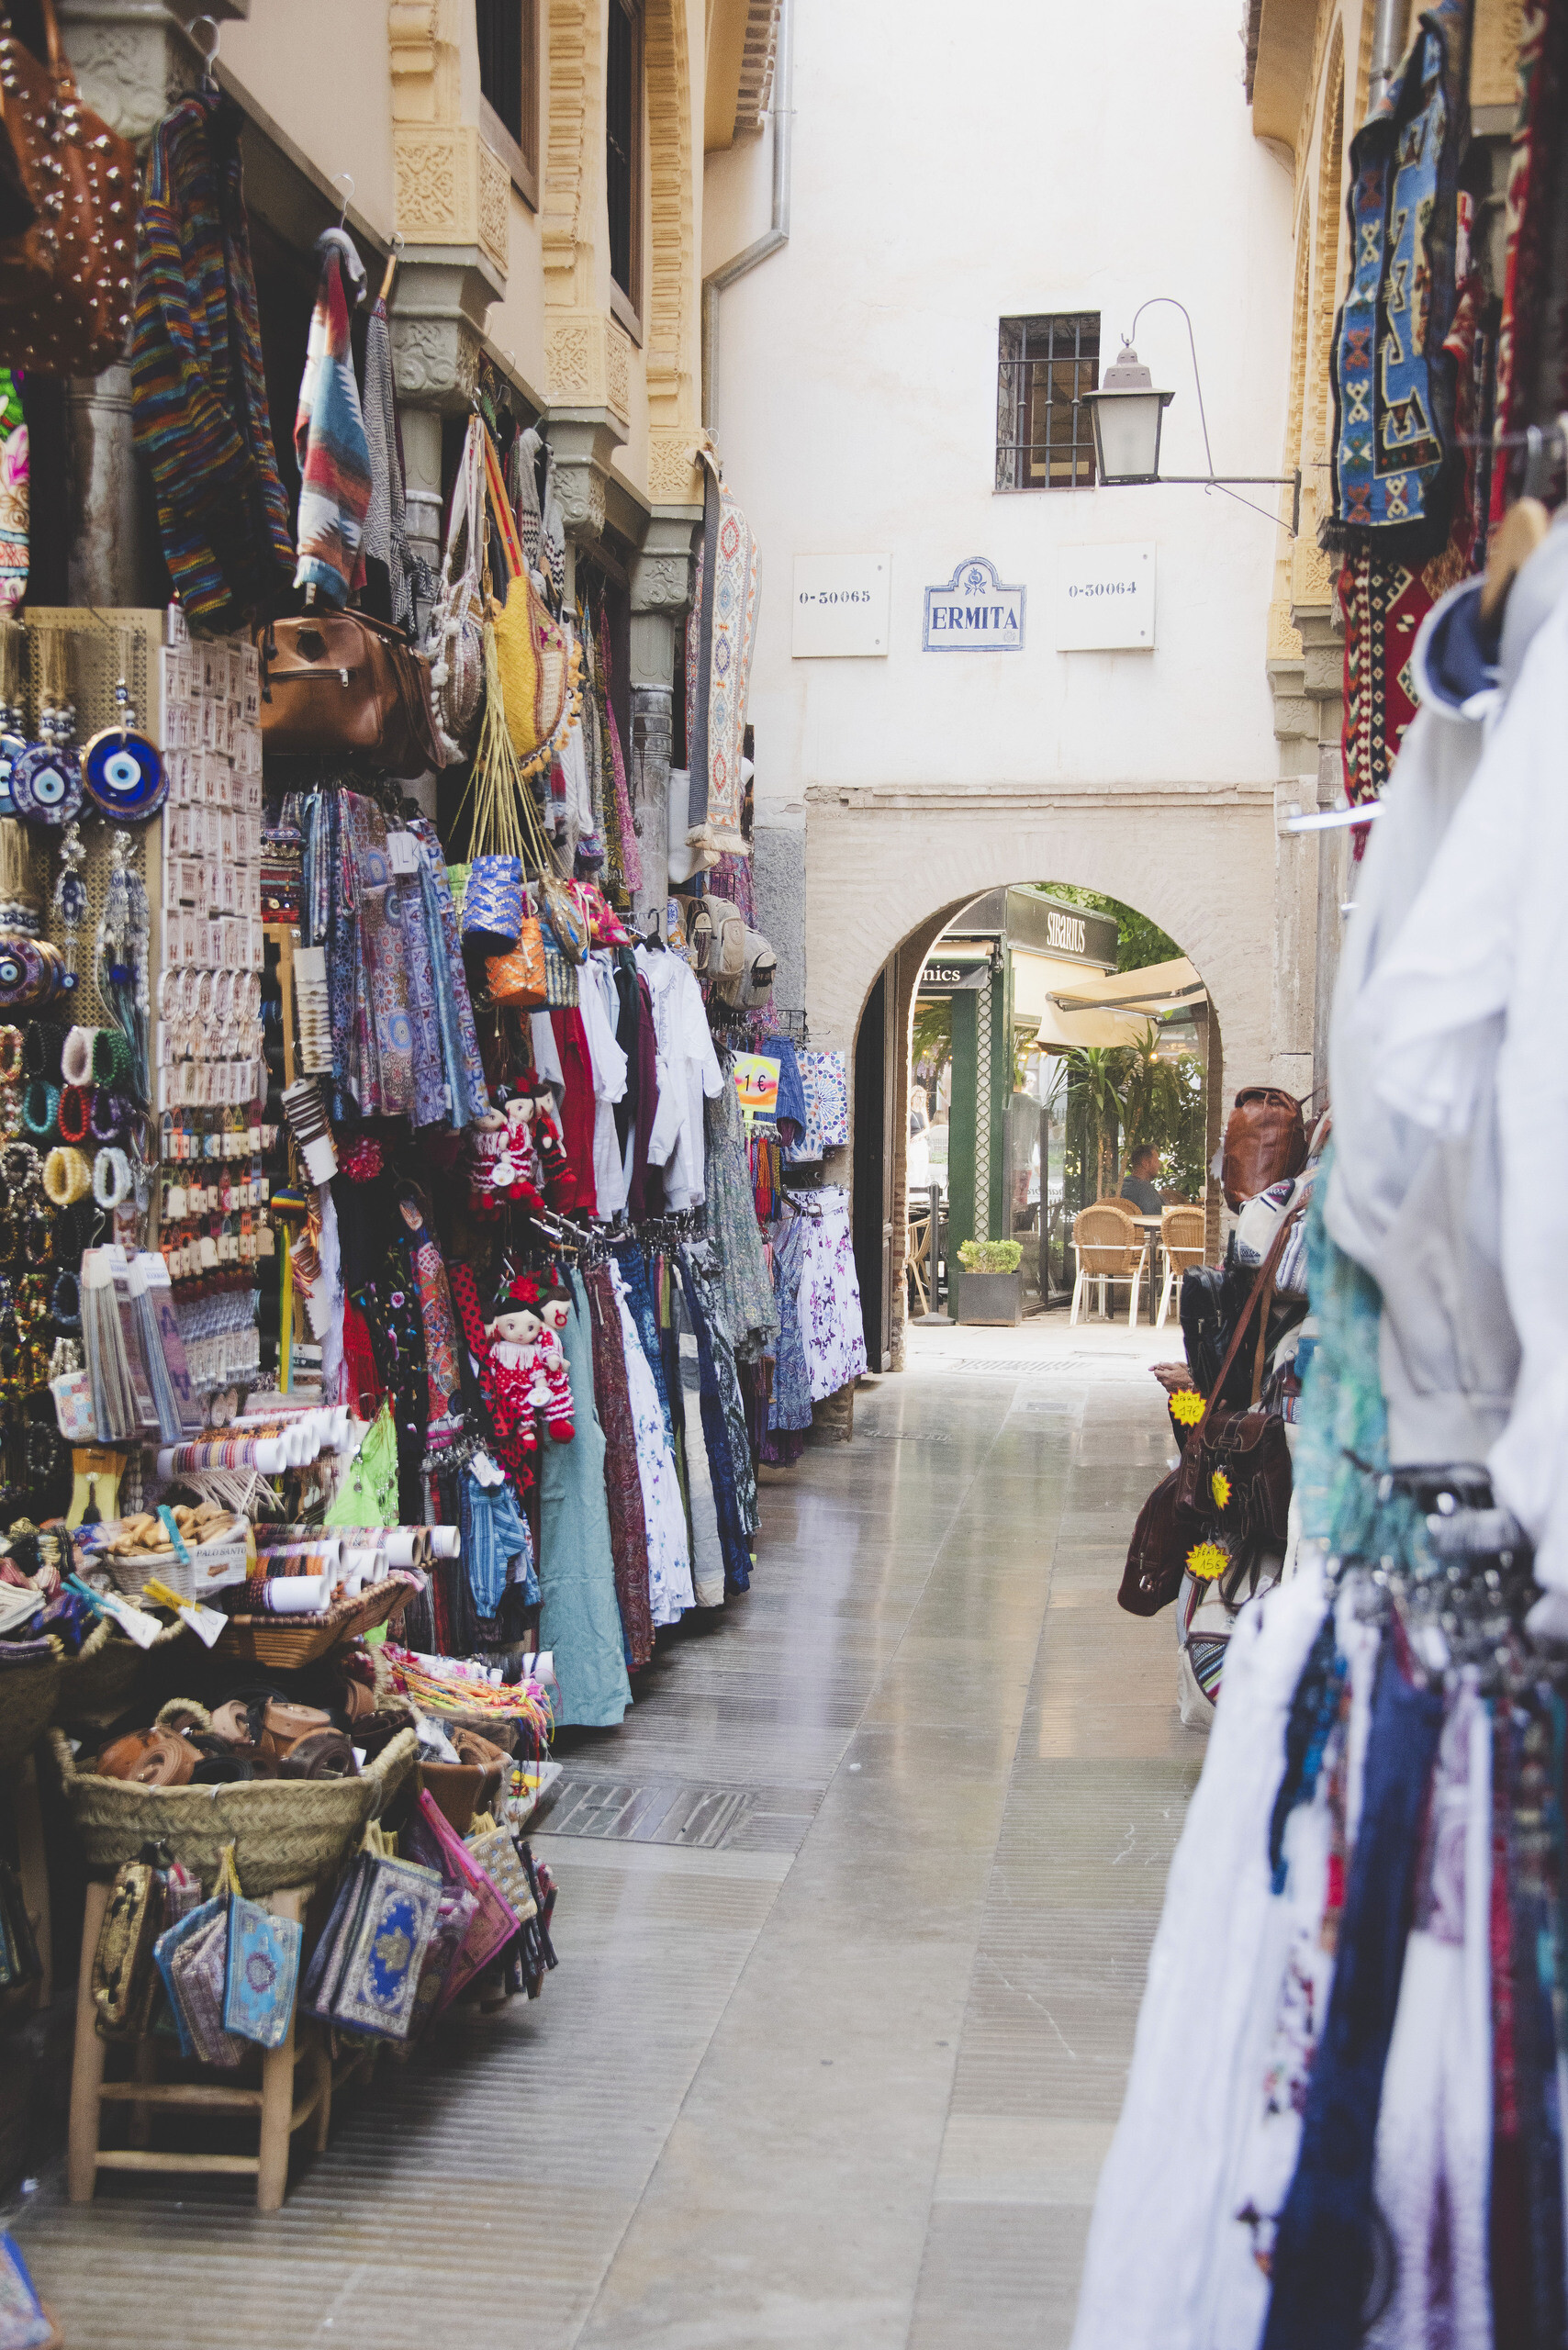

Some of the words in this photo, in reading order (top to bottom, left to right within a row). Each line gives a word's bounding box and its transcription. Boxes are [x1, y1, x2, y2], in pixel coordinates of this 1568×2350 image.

[931, 606, 1019, 630] ERMITA
[745, 1074, 750, 1091] 1
[757, 1074, 767, 1092] €
[196, 1548, 219, 1557] PALO
